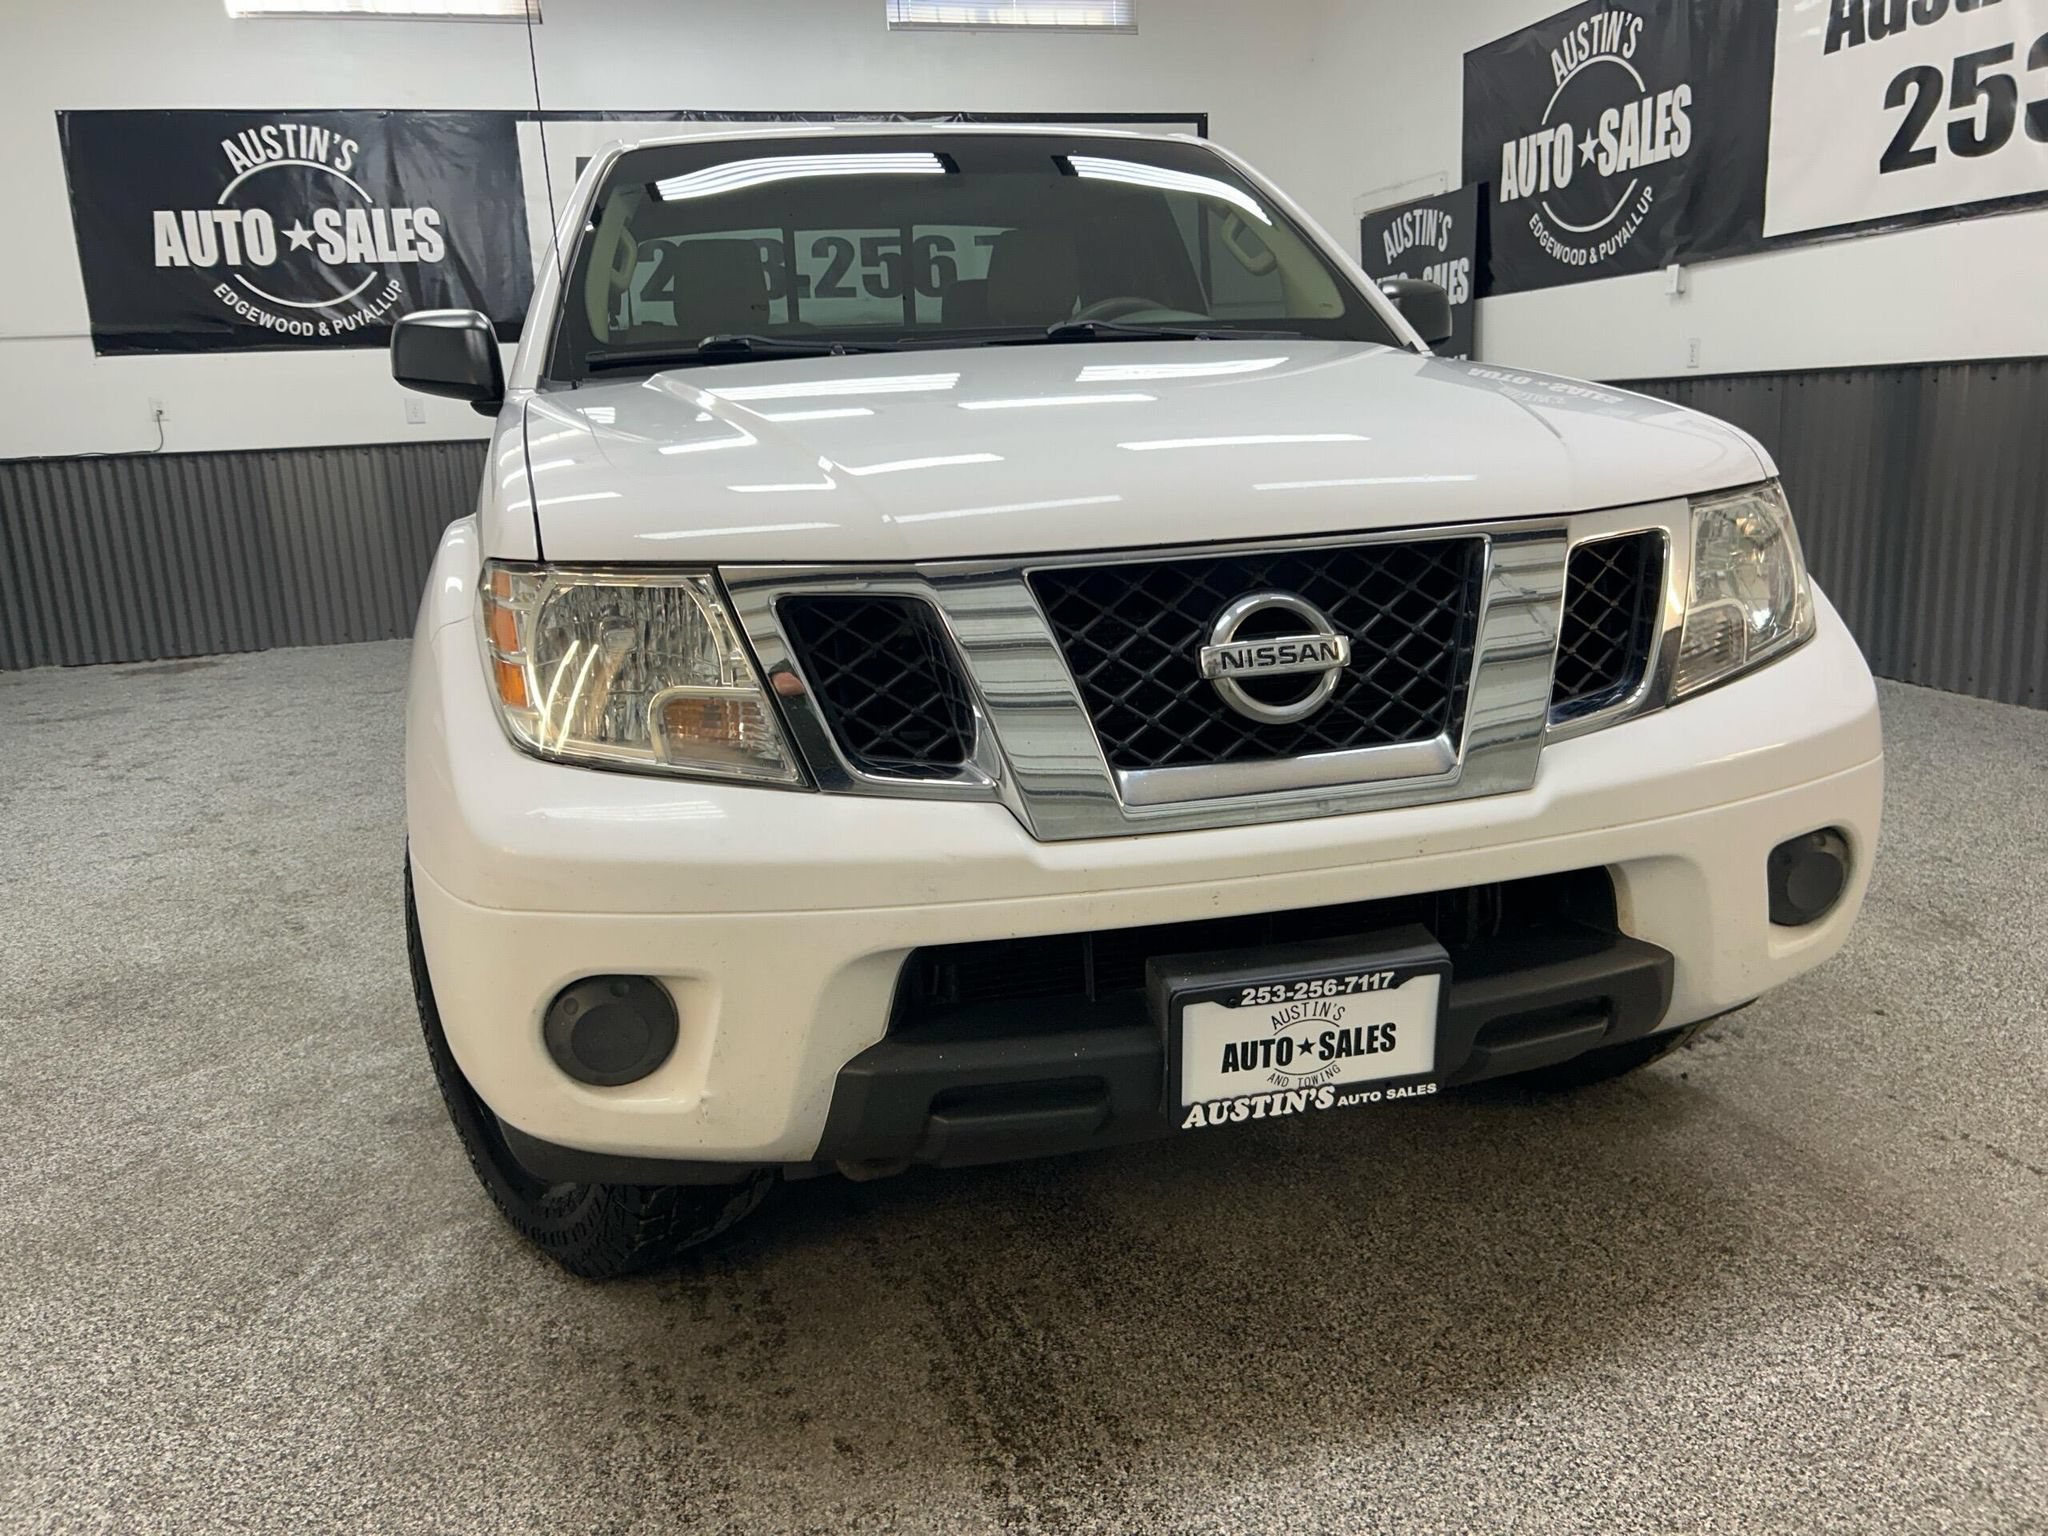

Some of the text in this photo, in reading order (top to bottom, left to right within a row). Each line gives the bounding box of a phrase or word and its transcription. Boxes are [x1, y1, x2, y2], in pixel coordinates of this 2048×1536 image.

[1551, 11, 1643, 86] AUSTIN'S
[221, 124, 358, 175] AUSTIN'S
[1500, 84, 1692, 203] AUTO SALES
[153, 207, 445, 267] AUTO SALES
[1383, 209, 1452, 265] AUSTIN'S
[1528, 186, 1653, 266] EDGEWOOD & PUYALLUP
[213, 279, 404, 337] EDGEWOOD & PUYALLUP
[1220, 641, 1340, 670] NISSAN
[1240, 972, 1395, 1006] 253-256-7117
[1271, 1001, 1346, 1030] AUSTIN'S
[1221, 1022, 1397, 1074] AUTO SALES
[1266, 1064, 1341, 1088] AND TOWING
[1181, 1083, 1437, 1129] AUSTIN'S AUTO SALES
